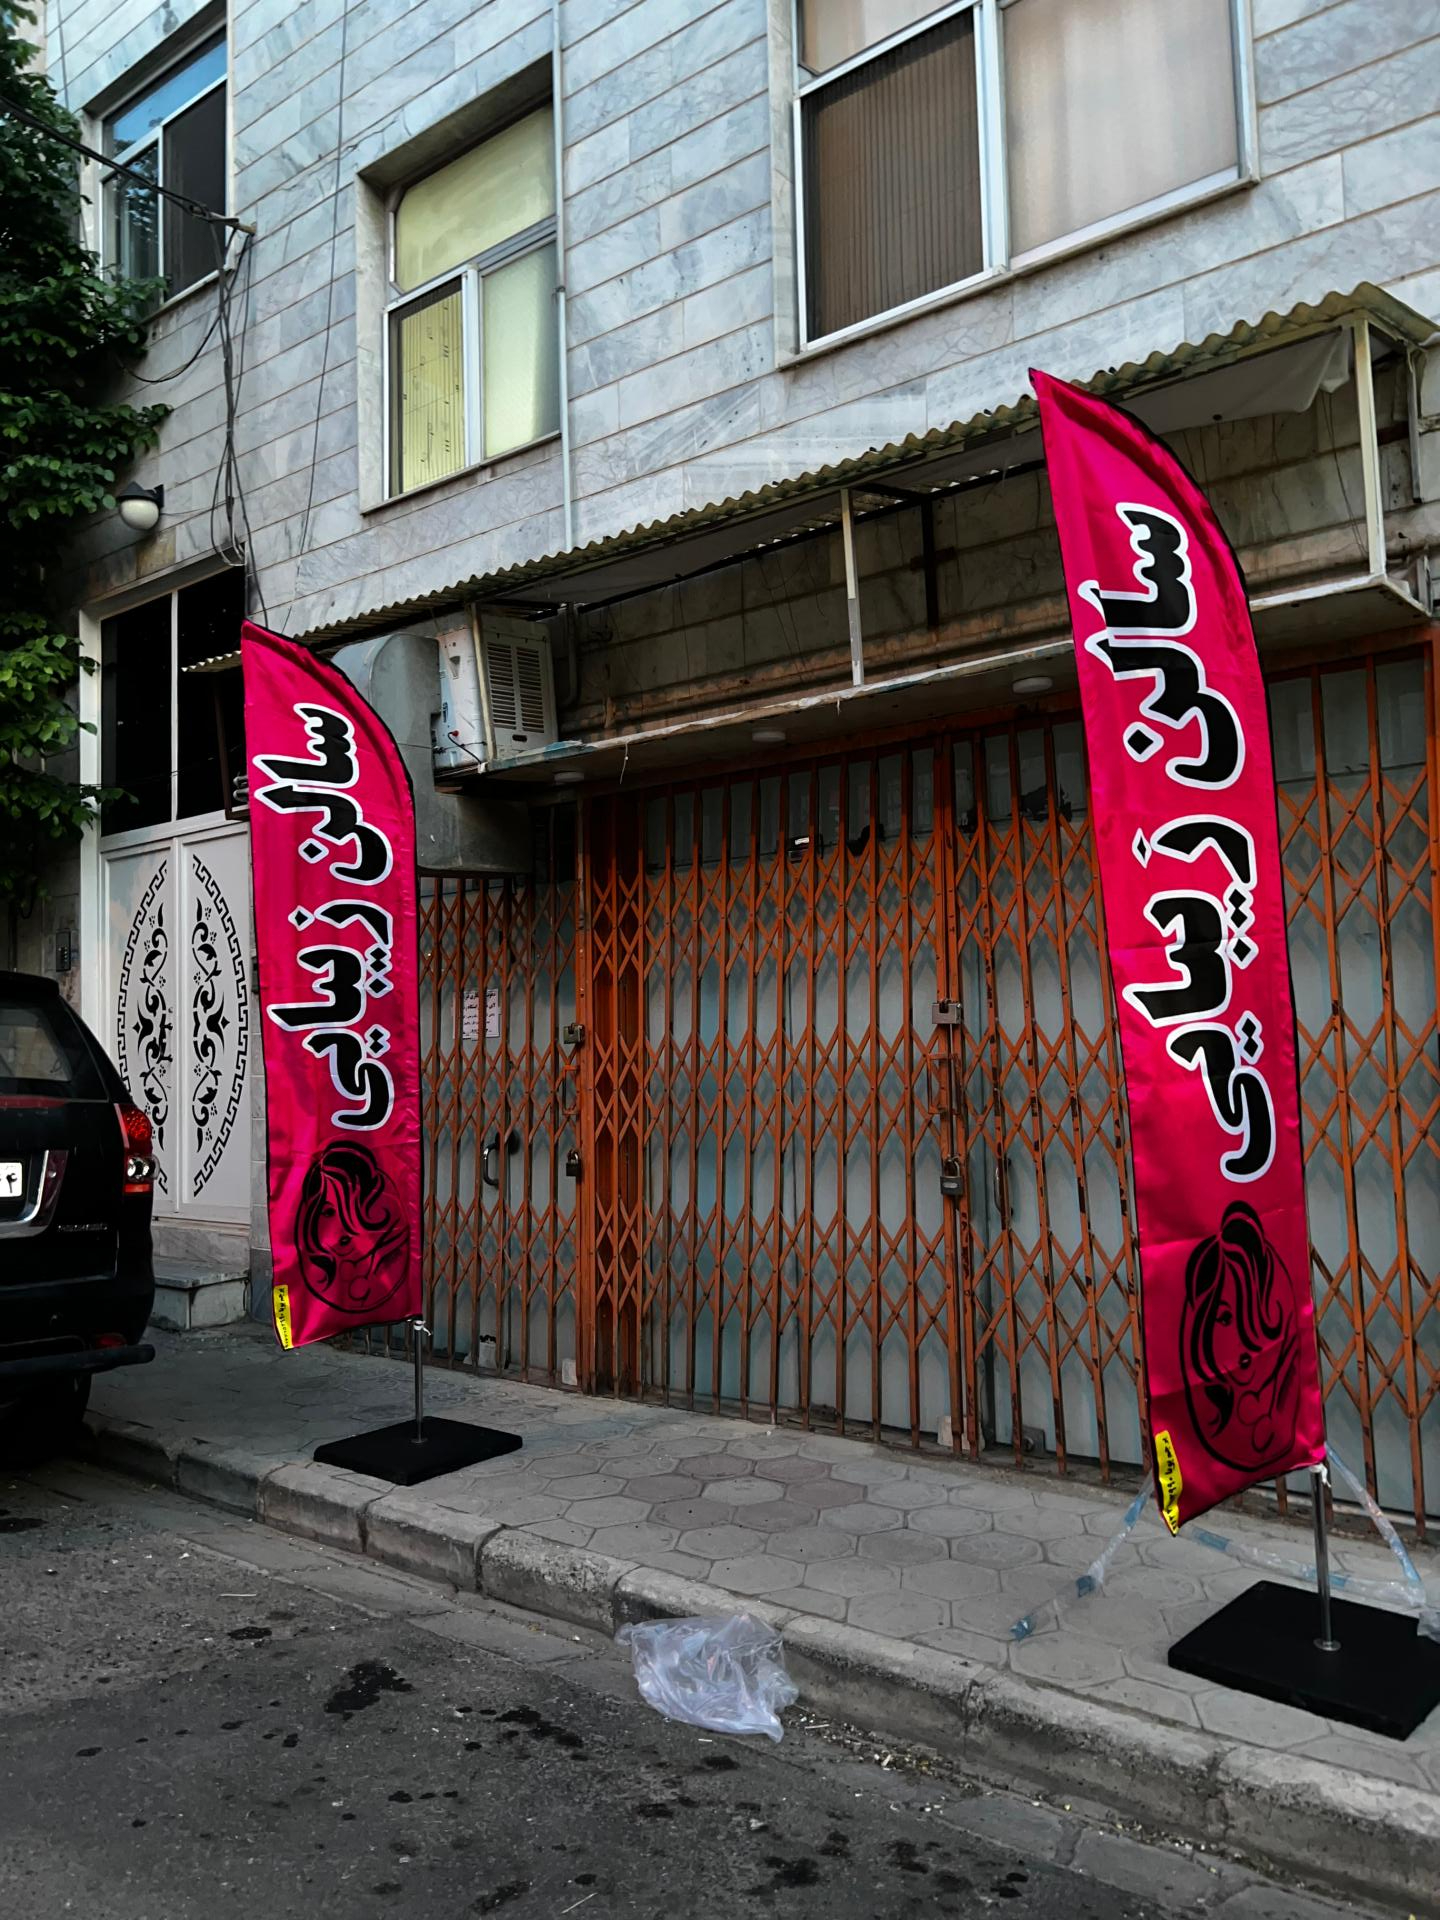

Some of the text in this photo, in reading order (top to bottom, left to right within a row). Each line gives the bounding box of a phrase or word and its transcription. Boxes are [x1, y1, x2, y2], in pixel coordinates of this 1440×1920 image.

[252, 702, 395, 1131] سالن زیبایی
[1077, 502, 1277, 1184] سالن زیبایی
[0, 1172, 18, 1194] ۴
